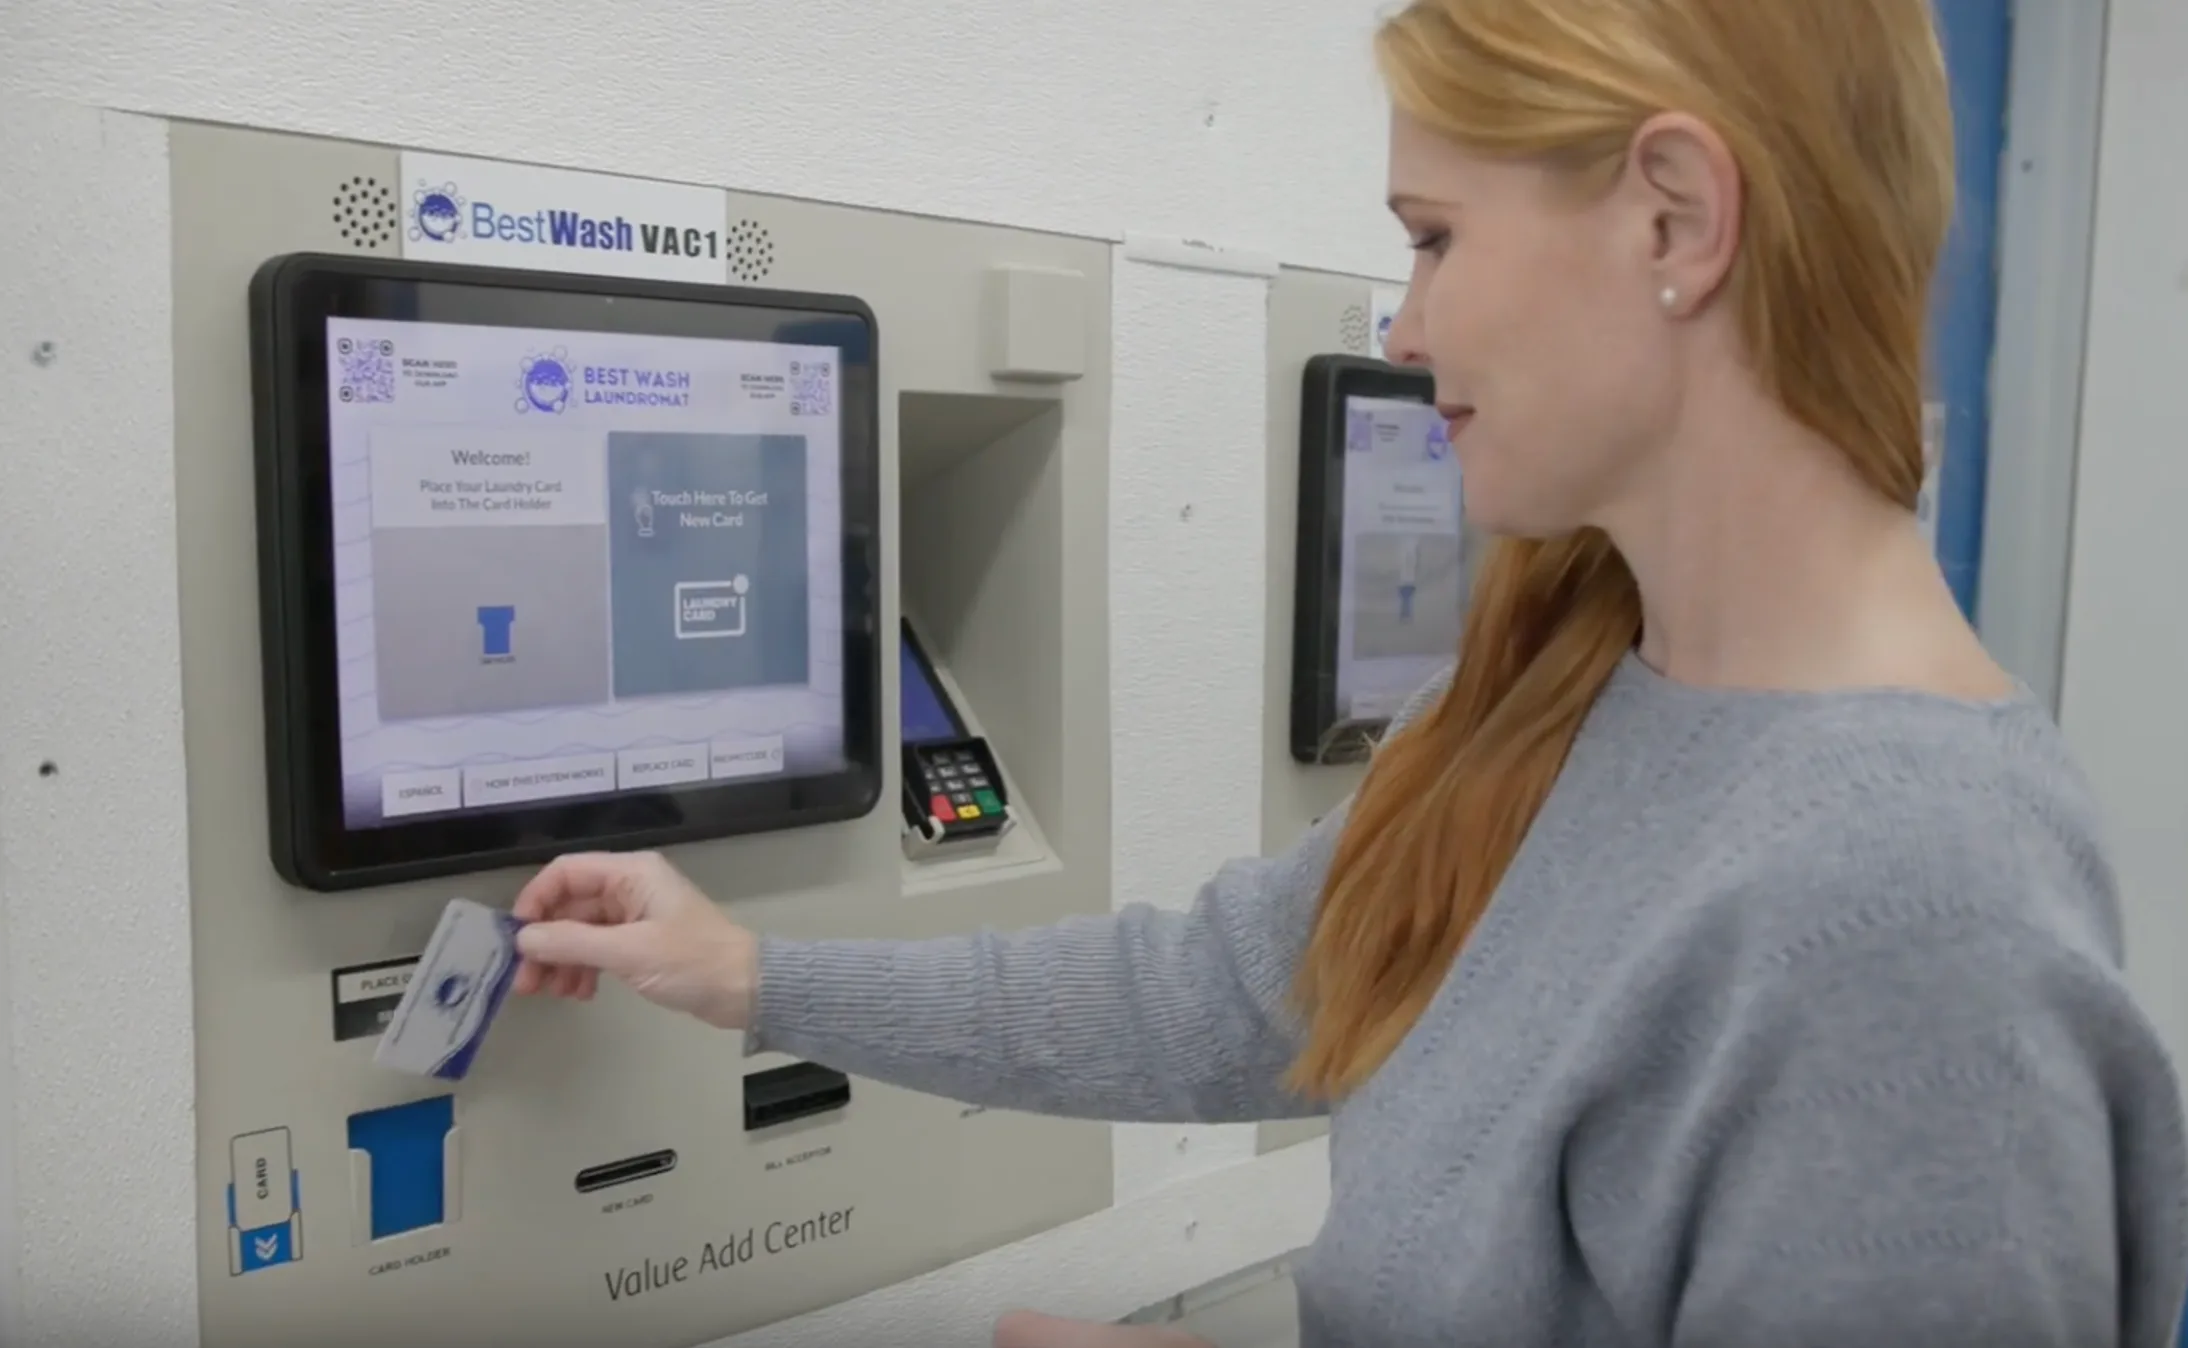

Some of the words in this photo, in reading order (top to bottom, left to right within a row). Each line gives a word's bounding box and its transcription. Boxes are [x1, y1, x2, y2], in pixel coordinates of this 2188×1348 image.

[641, 223, 717, 259] VAC1
[584, 367, 629, 386] BEST
[635, 370, 690, 388] WASH
[584, 390, 689, 407] LAUNDROMAT
[450, 449, 531, 466] Welcome!
[420, 479, 452, 493] Place
[455, 480, 483, 493] Your
[485, 480, 531, 495] Laundry
[534, 480, 562, 493] Card
[431, 498, 456, 511] Into
[458, 497, 480, 511] The
[483, 498, 511, 511] Card
[514, 498, 551, 510] Holder
[652, 490, 692, 506] Touch
[694, 490, 726, 506] Here
[728, 490, 743, 505] To
[745, 490, 769, 505] Get
[680, 512, 710, 527] New
[713, 512, 743, 527] Card
[683, 597, 738, 609] LAUNDRY
[683, 610, 716, 622] CARD
[632, 761, 668, 773] REPLACE
[671, 759, 695, 769] CARD
[485, 779, 510, 789] HOW
[361, 975, 399, 991] PLACE
[786, 1146, 831, 1166] ACCEPTOR
[256, 1157, 269, 1200] CARD
[602, 1202, 624, 1214] NEW
[626, 1193, 653, 1209] CARD
[368, 1260, 400, 1276] CARD
[404, 1247, 451, 1269] HOLDER
[605, 1256, 688, 1301] Value
[699, 1229, 753, 1274] Add
[764, 1206, 855, 1254] Center
